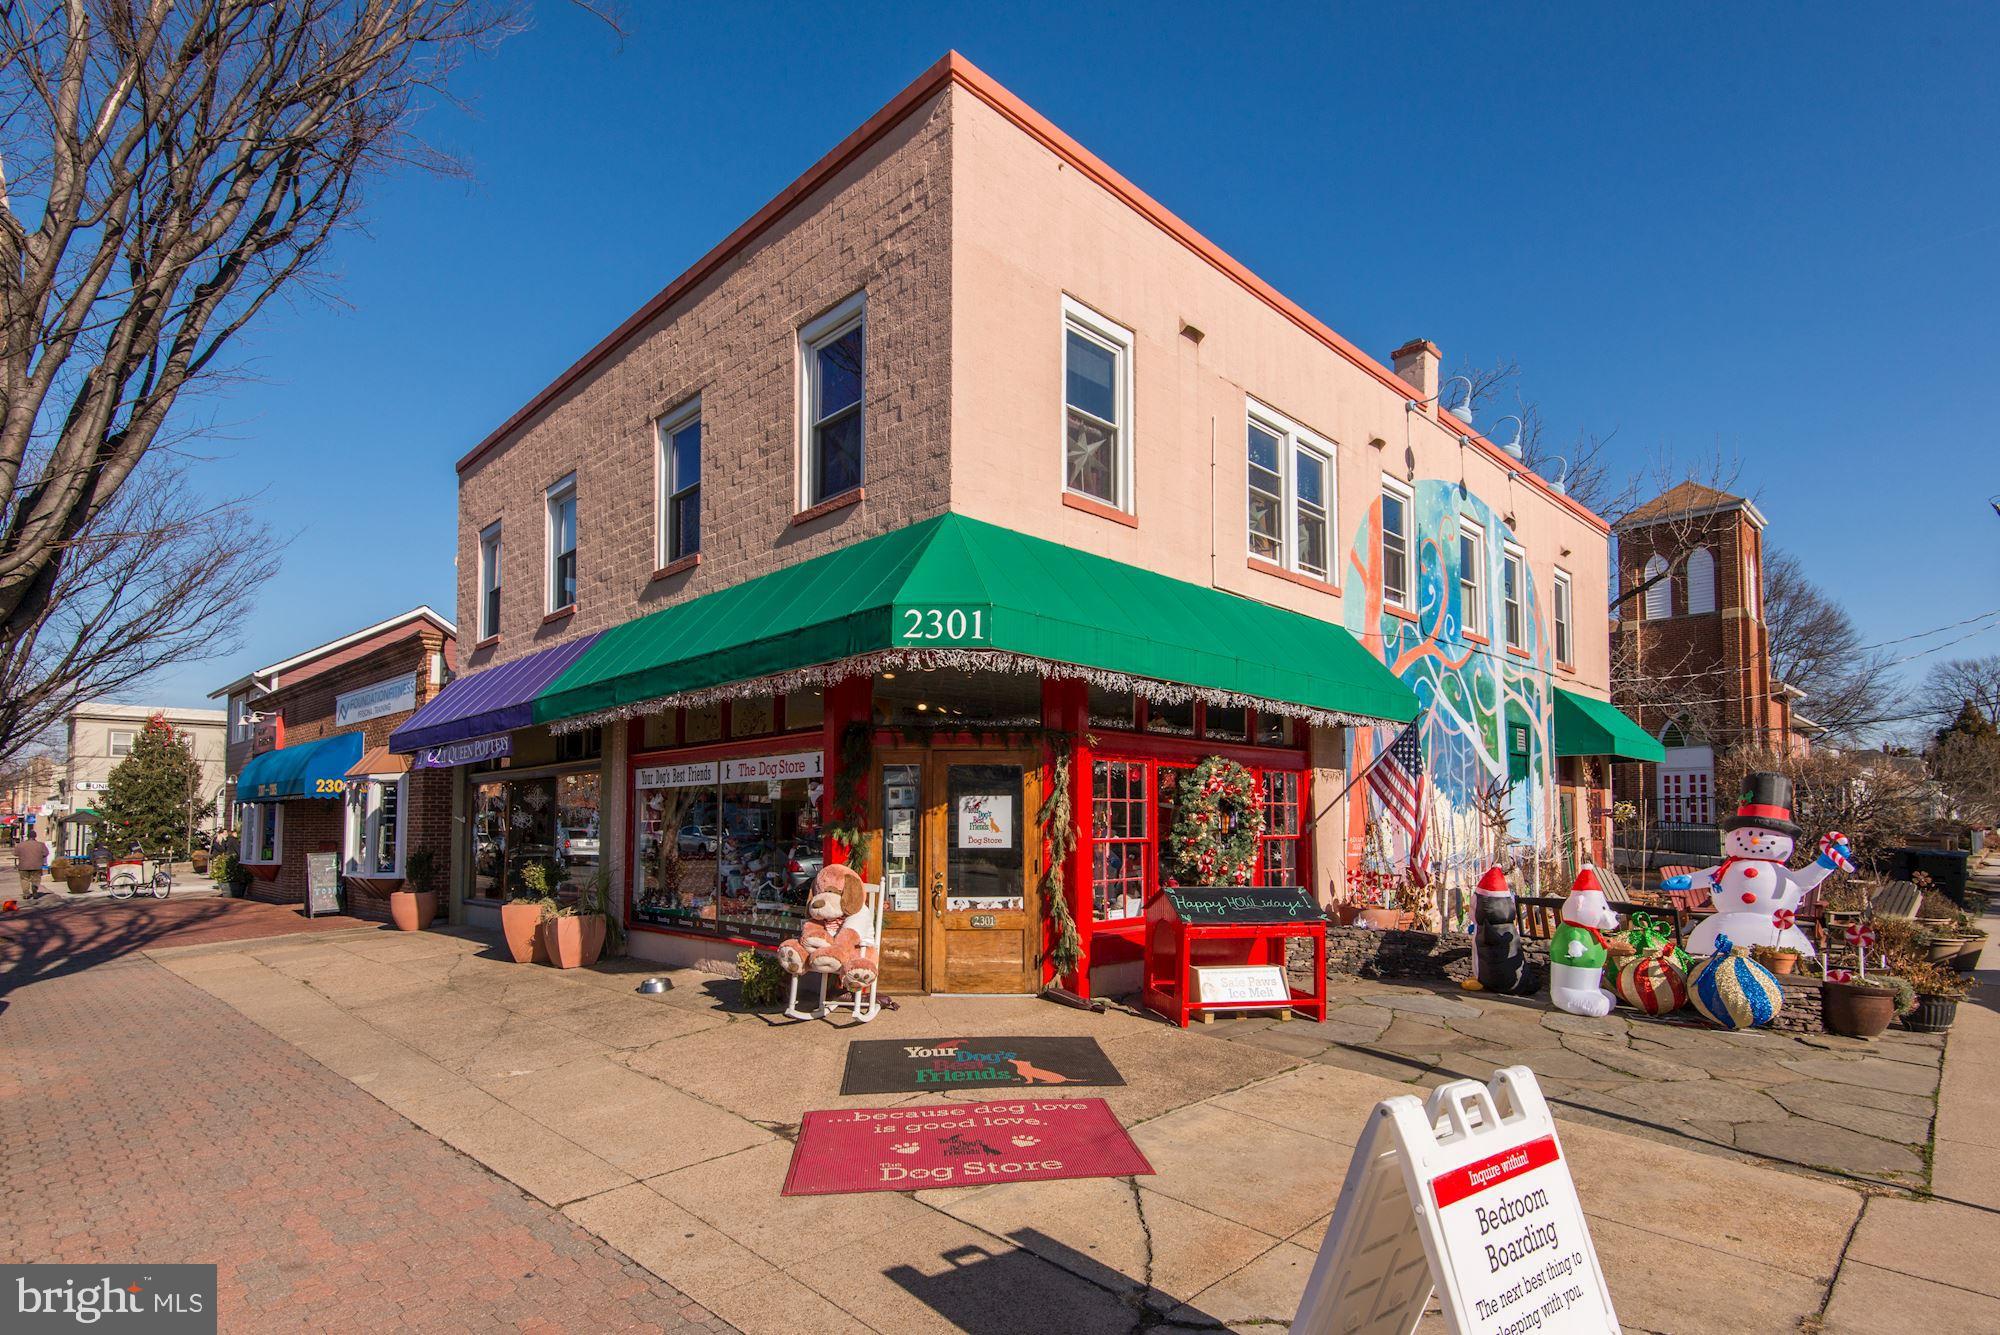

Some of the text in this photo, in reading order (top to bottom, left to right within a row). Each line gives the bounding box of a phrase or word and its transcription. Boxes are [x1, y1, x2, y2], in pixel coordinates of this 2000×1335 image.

[903, 609, 984, 640] 2301
[474, 736, 510, 758] POTTERY
[642, 765, 712, 787] Your Dog's Best Friends
[738, 759, 806, 779] The Dog Store
[968, 836, 1003, 845] Dog Store
[1171, 895, 1226, 915] Happy
[974, 914, 995, 926] 2301
[1247, 976, 1278, 987] Paws
[1228, 986, 1275, 999] Ice Melt
[903, 1046, 1017, 1065] Your Dog's
[915, 1066, 1012, 1083] Friends
[973, 1102, 1026, 1115] dog
[1033, 1101, 1088, 1113] love
[873, 1116, 1049, 1135] is good love.
[879, 1159, 1064, 1182] Dog Store
[1468, 1150, 1530, 1187] Inquire within!
[1475, 1187, 1550, 1236] Bedroom
[1484, 1221, 1560, 1274] Boarding
[1475, 1251, 1583, 1321] The next best thing to
[1495, 1284, 1585, 1335] leeping with you.
